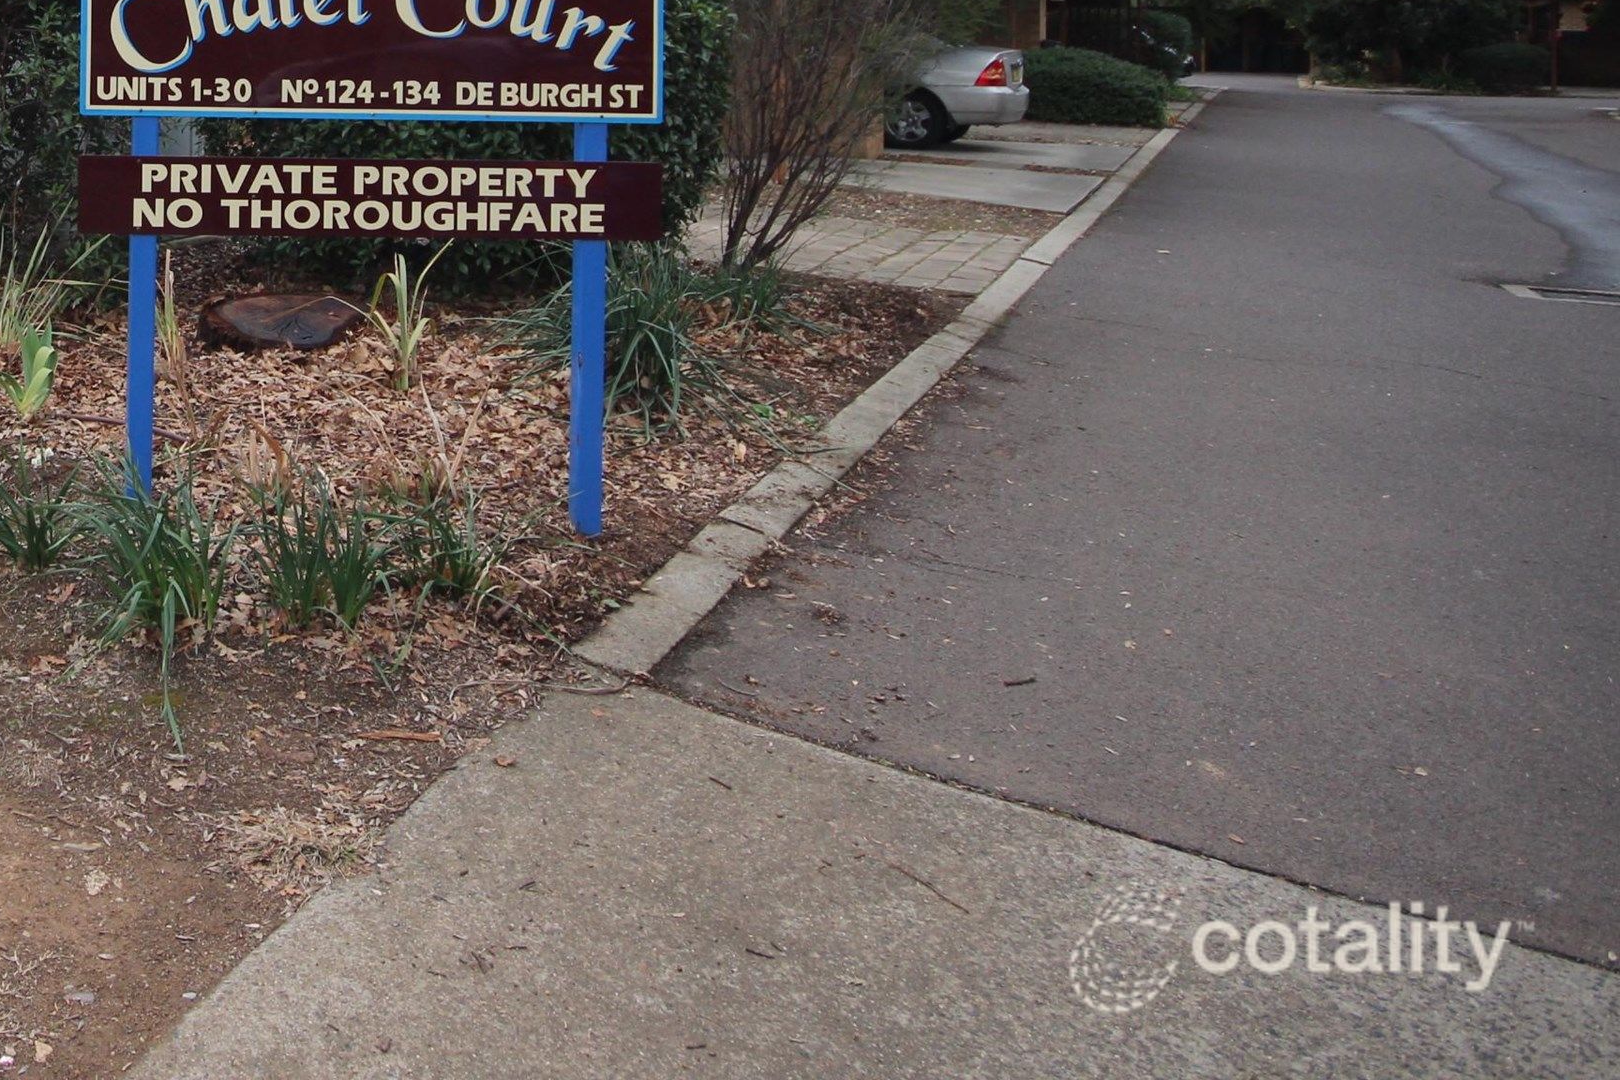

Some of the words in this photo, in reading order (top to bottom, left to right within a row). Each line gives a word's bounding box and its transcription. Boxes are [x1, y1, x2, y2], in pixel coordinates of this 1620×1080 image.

[96, 75, 182, 102] UNITS
[190, 77, 252, 103] 1-30
[455, 81, 495, 107] DE
[499, 81, 603, 109] BURGH
[608, 83, 645, 110] ST
[141, 163, 338, 195] PRIVATE
[353, 165, 597, 198] PROPERTY
[132, 198, 203, 229] NO
[220, 199, 605, 233] THOROUGHFARE
